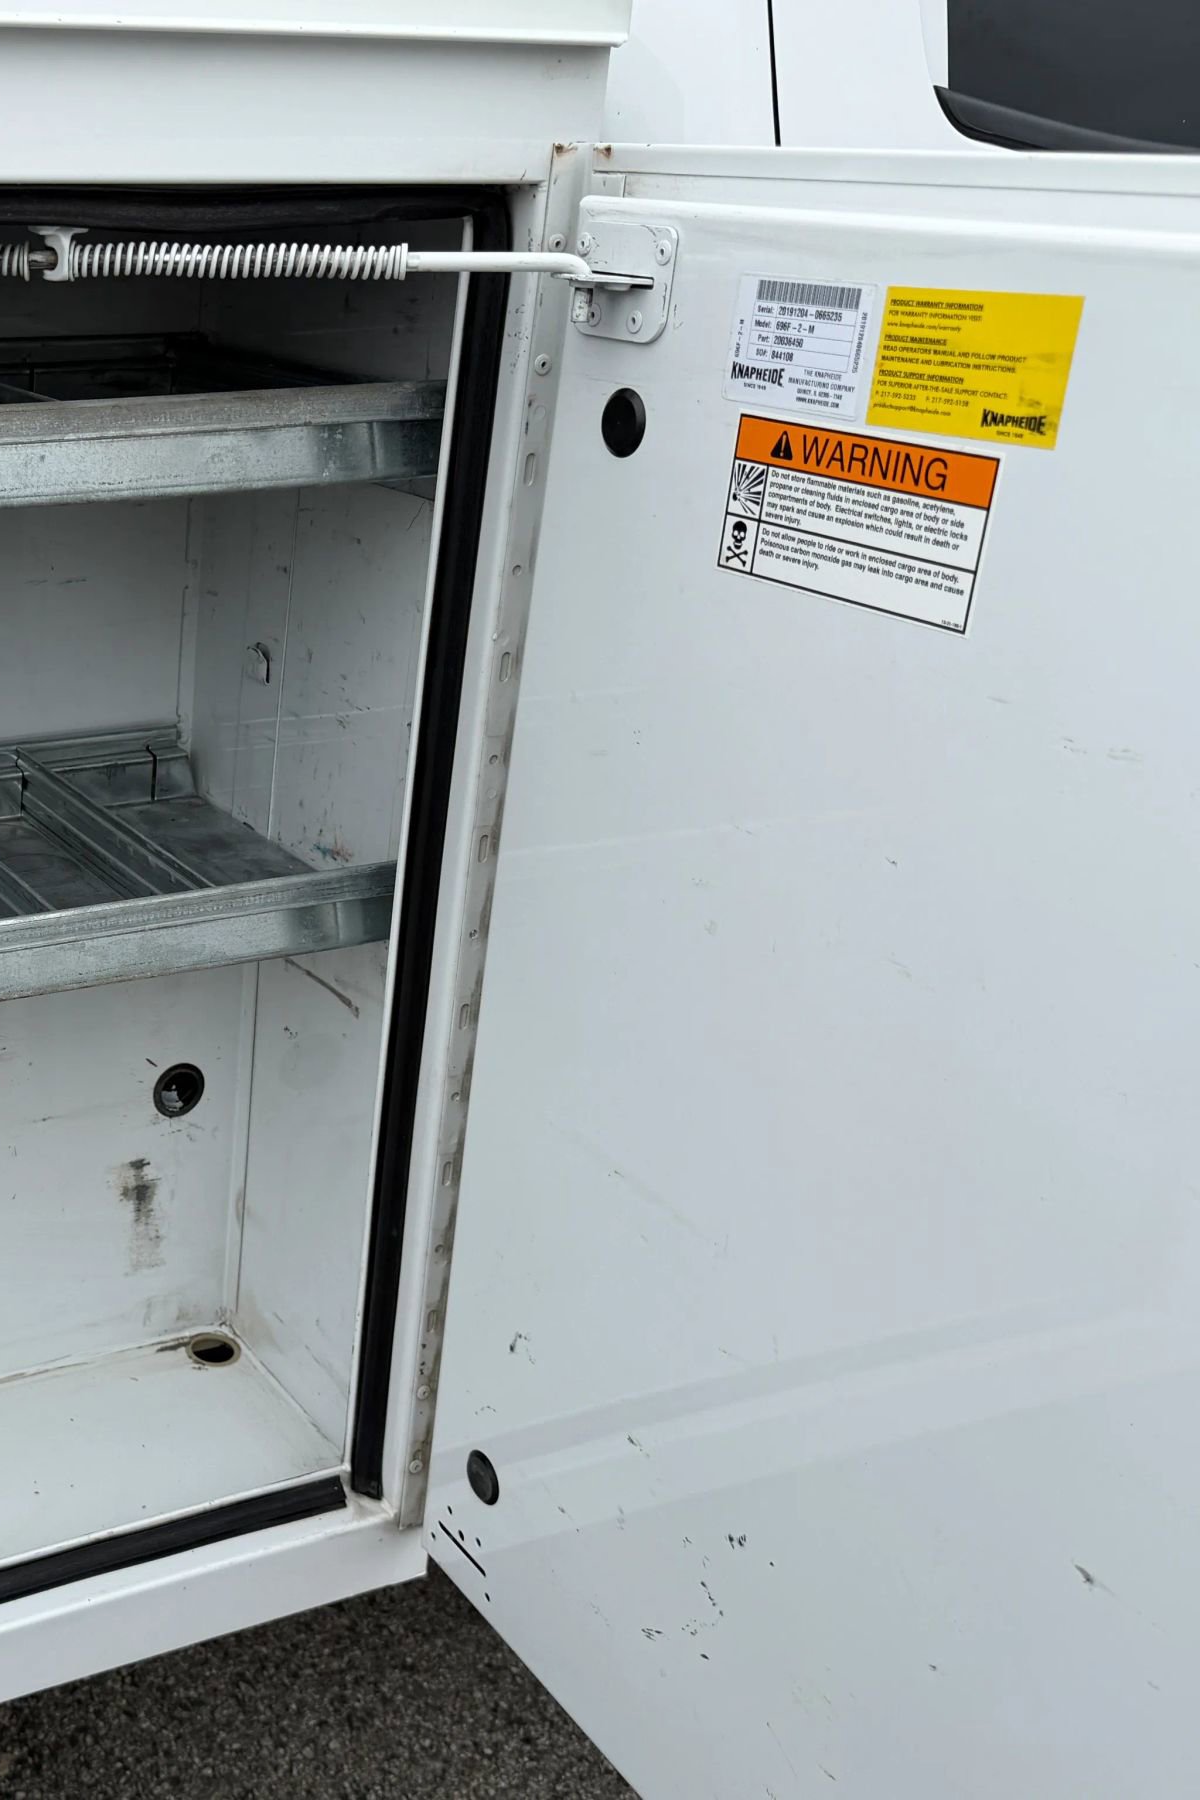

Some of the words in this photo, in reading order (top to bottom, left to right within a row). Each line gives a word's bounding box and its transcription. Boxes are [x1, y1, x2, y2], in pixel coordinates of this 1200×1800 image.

[916, 300, 943, 308] WARRANTY
[944, 302, 983, 310] INFORMATION
[754, 319, 772, 328] Model:
[929, 312, 967, 320] INFORMATION
[884, 334, 908, 342] PRODUCT
[910, 336, 946, 345] MAINTENANCE
[771, 349, 793, 361] 844108
[881, 355, 918, 363] MAINTENANCE
[933, 360, 970, 368] LUBRICATION
[898, 346, 931, 354] OPERATORS
[971, 352, 995, 360] FOLLOW
[997, 355, 1026, 363] PRODUCT
[731, 360, 785, 387] KNAPHEIDE
[814, 371, 841, 380] KNAPHEIDE
[879, 369, 901, 377] PRODUCT
[903, 371, 925, 380] SUPPORT
[927, 374, 963, 384] INFORMATION
[788, 376, 829, 389] MANUFACTURING
[830, 383, 855, 393] COMPANY
[888, 381, 912, 389] SUPERIOR
[954, 388, 978, 396] SUPPORT
[981, 408, 1047, 435] KNAPHEIDE
[803, 434, 948, 491] WARNING
[771, 469, 779, 478] Do
[780, 472, 790, 480] not
[791, 474, 805, 483] store
[807, 477, 836, 490] flammable
[838, 483, 865, 496] materials
[866, 489, 881, 499] such
[892, 495, 921, 509] gasoline,
[922, 501, 956, 517] acetylene,
[769, 481, 792, 492] propane
[801, 486, 825, 500] cleaning
[826, 492, 843, 502] fluids
[844, 495, 850, 503] in
[851, 497, 879, 510] enclosed
[880, 505, 898, 516] cargo
[899, 509, 913, 517] area
[914, 510, 922, 519] of
[923, 512, 939, 525] body
[950, 518, 964, 528] side
[765, 511, 783, 520] severe
[784, 514, 801, 526] injury.
[768, 490, 807, 506] compartments
[809, 498, 815, 506] of
[816, 500, 831, 512] body.
[835, 504, 863, 517] Electrical
[864, 511, 893, 525] switches,
[893, 517, 914, 530] lights,
[924, 524, 948, 536] electric
[949, 530, 968, 541] locks
[766, 502, 777, 511] may
[779, 503, 794, 514] spark
[796, 507, 807, 515] and
[808, 511, 824, 520] cause
[834, 515, 864, 530] explosion
[865, 522, 883, 533] which
[884, 527, 902, 537] could
[904, 531, 922, 542] result
[923, 535, 930, 544] in
[931, 537, 950, 548] death
[759, 547, 774, 557] death
[782, 555, 801, 564] severe
[802, 558, 819, 571] injury.
[762, 527, 770, 535] Do
[771, 530, 780, 538] not
[781, 532, 795, 542] allow
[797, 536, 816, 549] people
[817, 541, 823, 549] to
[824, 543, 836, 552] ride
[845, 548, 859, 558] work
[861, 552, 867, 560] in
[868, 553, 896, 567] enclosed
[897, 562, 916, 574] cargo
[917, 567, 931, 576] area
[932, 569, 941, 578] of
[941, 571, 959, 585] body.
[760, 537, 789, 551] Poisonous
[790, 545, 810, 556] carbon
[811, 550, 840, 564] monoxide
[841, 559, 852, 569] gas
[853, 562, 865, 572] may
[867, 564, 880, 574] leak
[881, 568, 894, 578] into
[894, 572, 913, 585] cargo
[914, 577, 928, 587] area
[930, 580, 942, 590] and
[944, 585, 964, 596] cause
